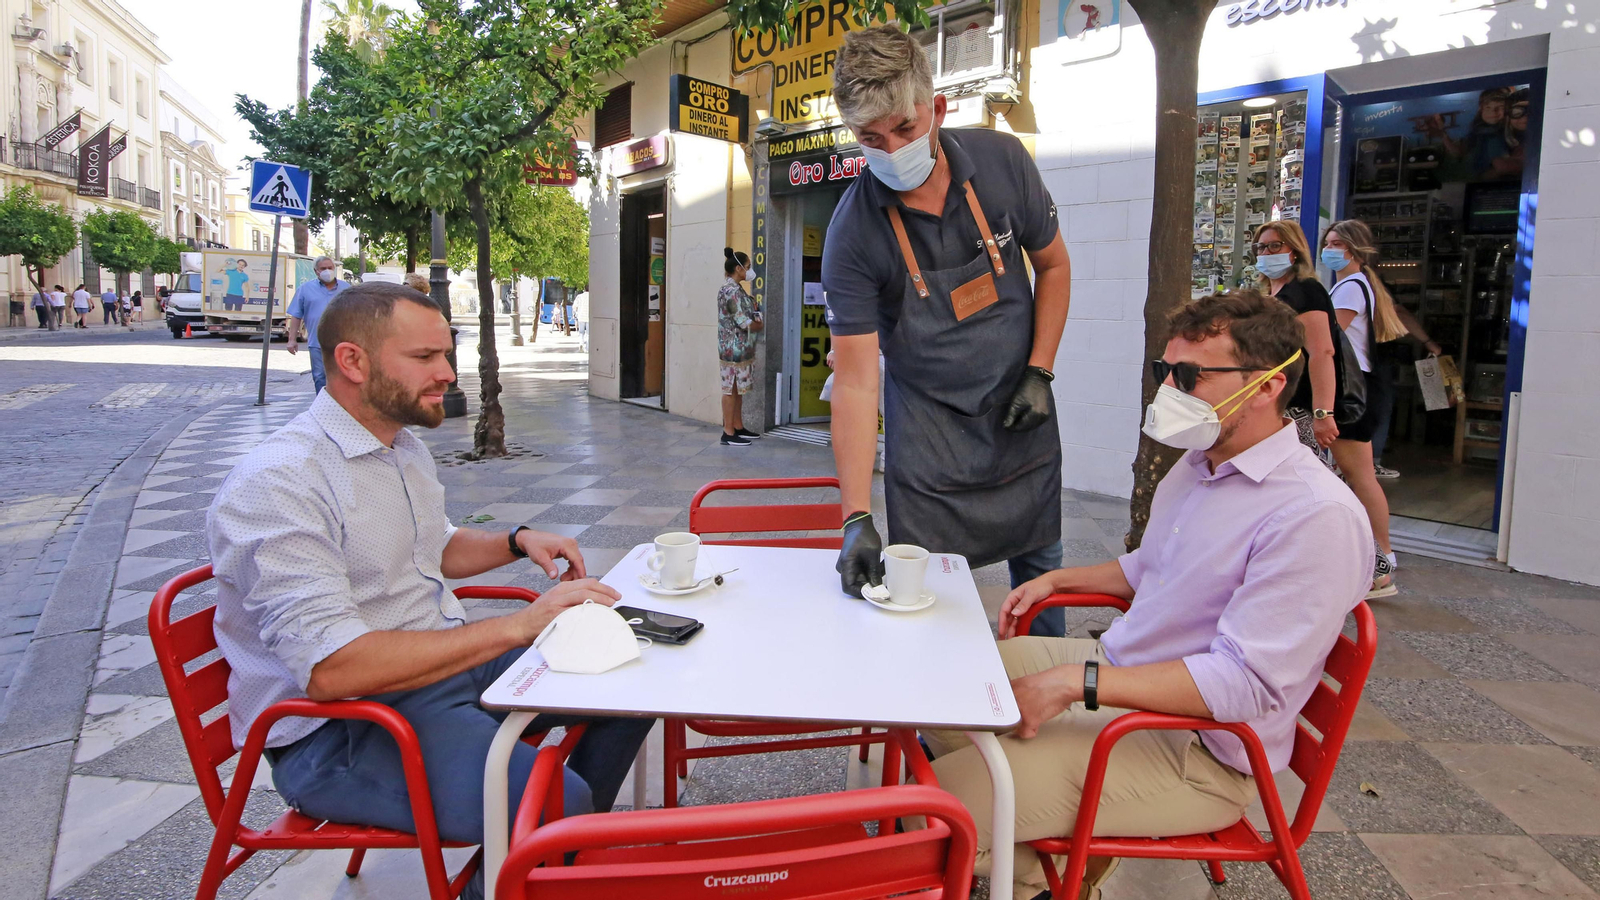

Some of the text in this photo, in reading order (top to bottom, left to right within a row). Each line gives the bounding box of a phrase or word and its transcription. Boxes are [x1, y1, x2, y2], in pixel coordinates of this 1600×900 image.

[689, 80, 729, 100] COMPRO
[689, 92, 729, 113] ORO
[689, 109, 729, 127] DINERO AL
[1364, 105, 1403, 122] inventa
[689, 122, 729, 140] INSTANTE
[769, 140, 794, 157] PAGO
[796, 134, 835, 153] MÁXIMO
[86, 143, 101, 184] KOKOA
[789, 161, 824, 186] Oro
[527, 170, 573, 180] BAOS
[755, 167, 766, 307] COMPRO OR
[703, 869, 789, 888] Cruzcampo
